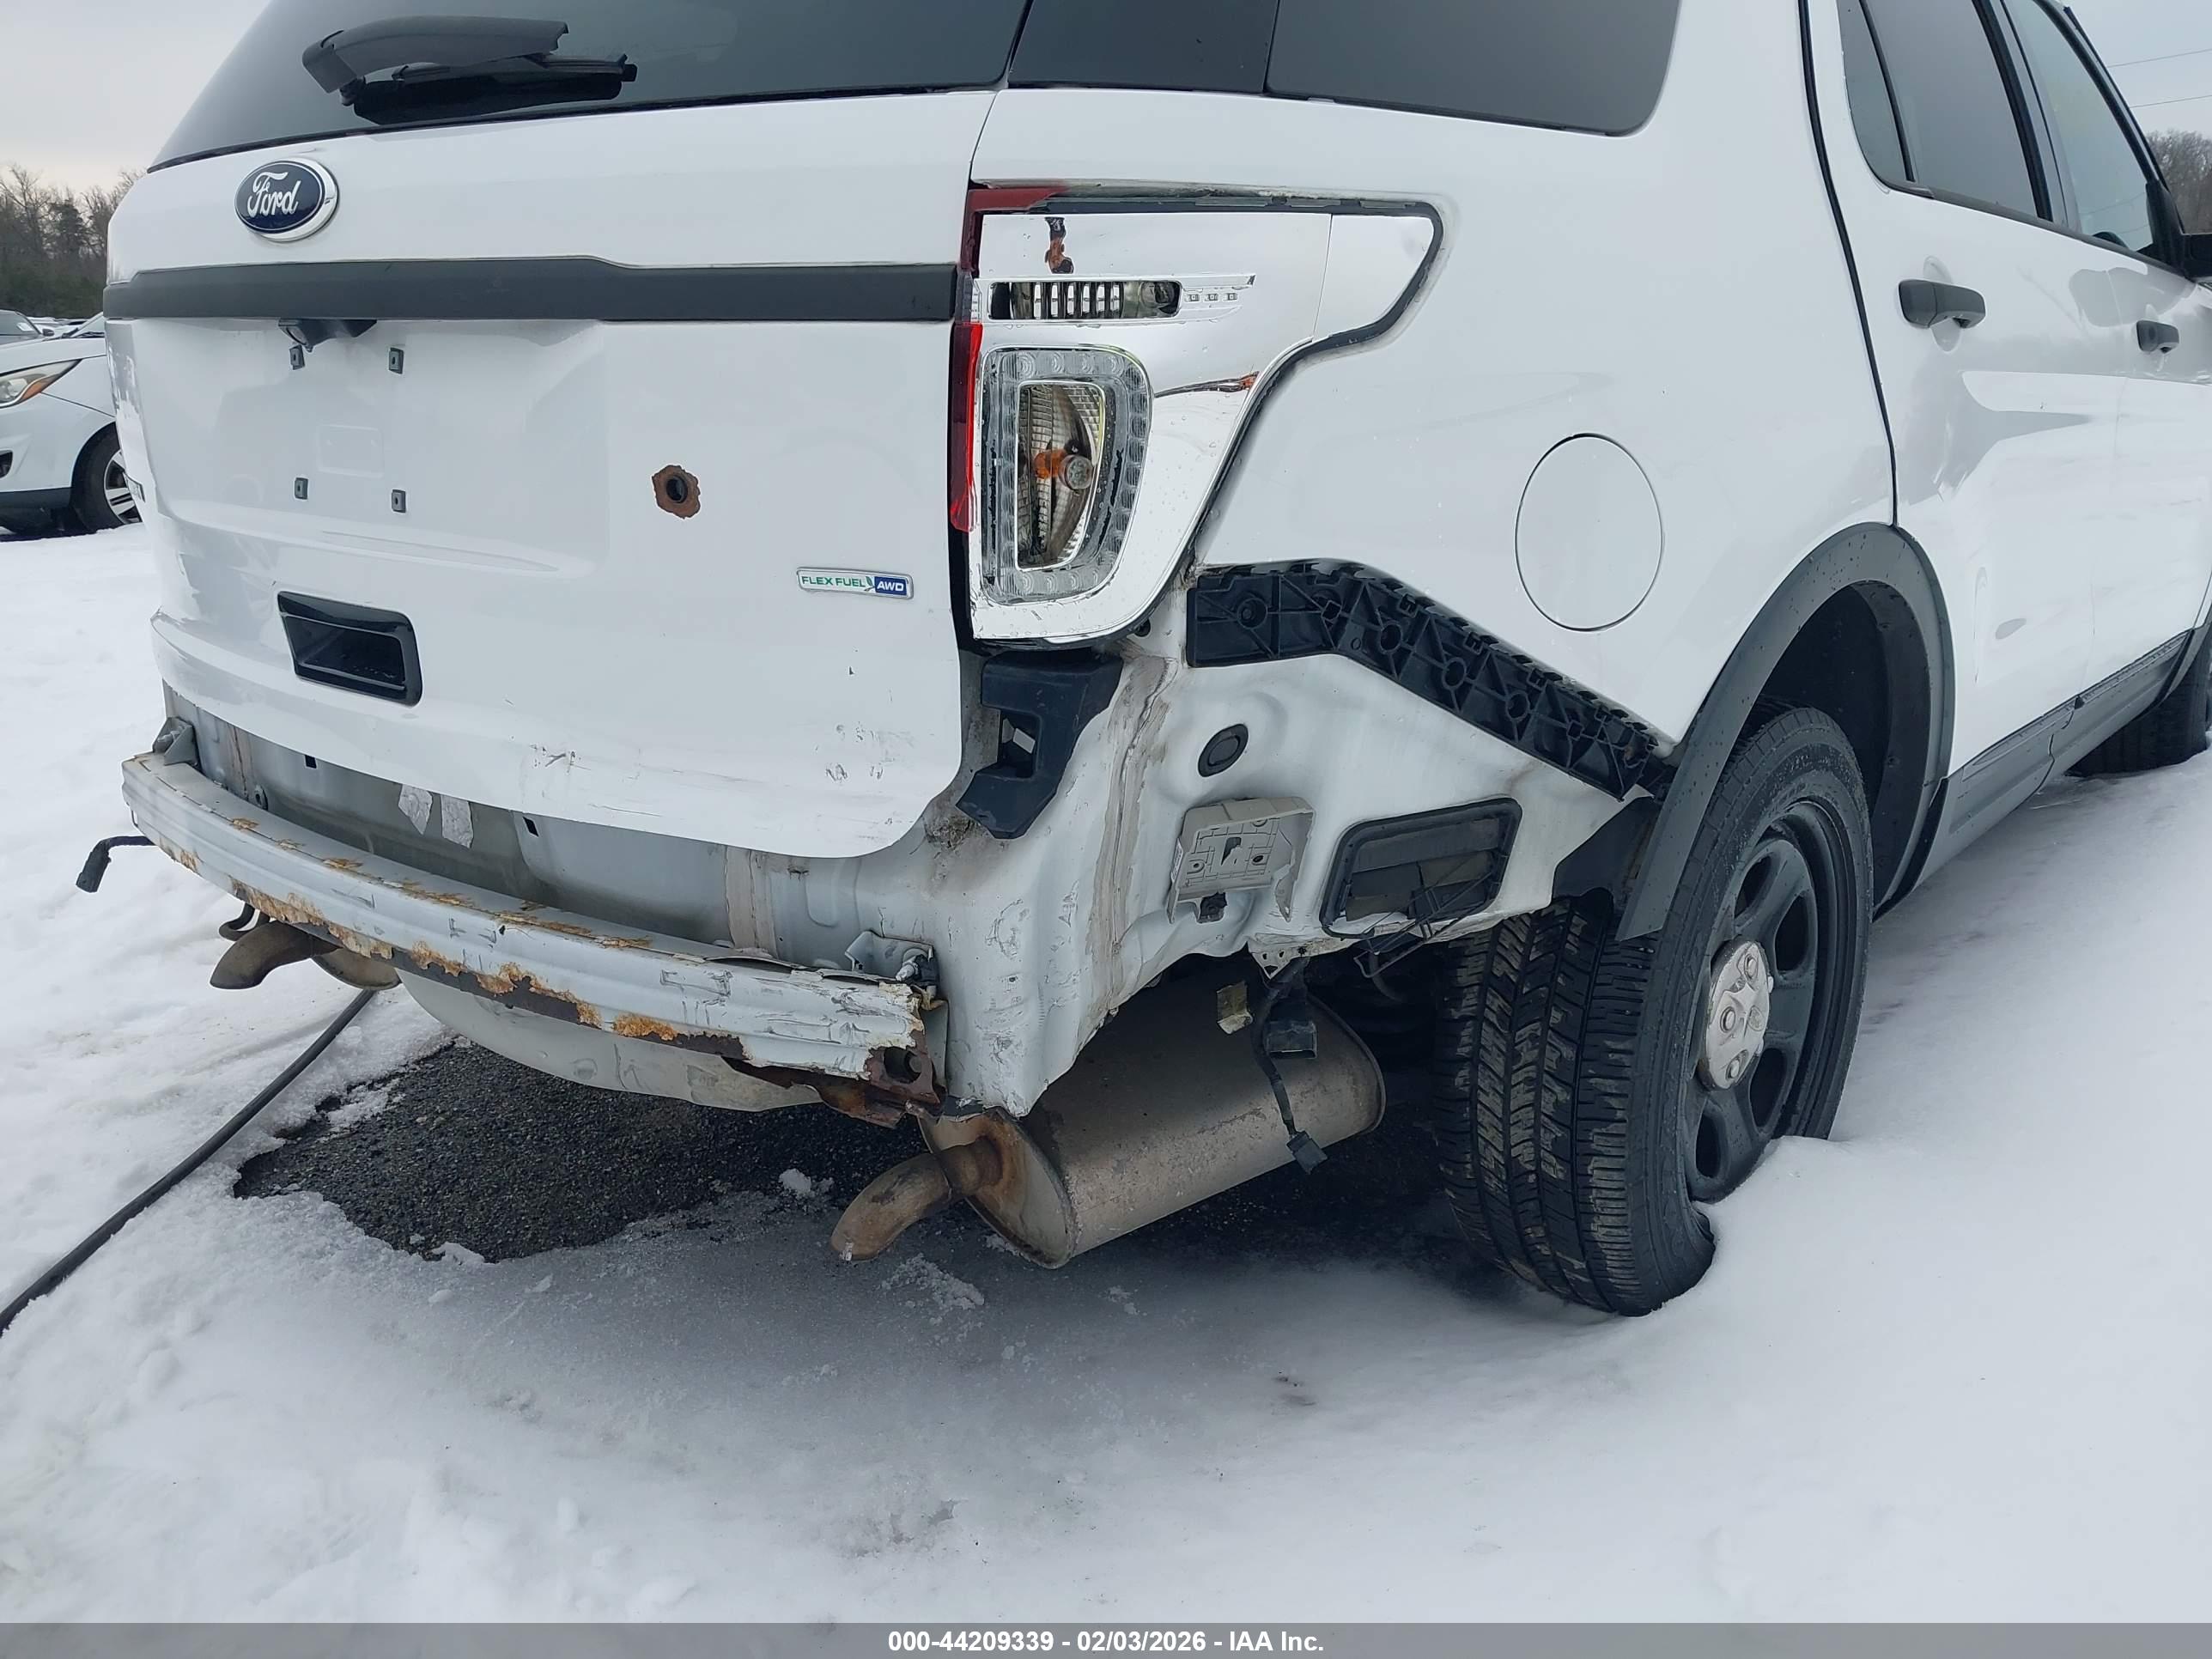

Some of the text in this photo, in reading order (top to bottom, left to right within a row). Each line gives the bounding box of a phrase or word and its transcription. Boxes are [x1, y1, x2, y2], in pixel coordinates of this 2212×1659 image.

[246, 172, 301, 218] Ford
[801, 575, 866, 587] FLEX FUEL
[877, 580, 905, 592] AWD
